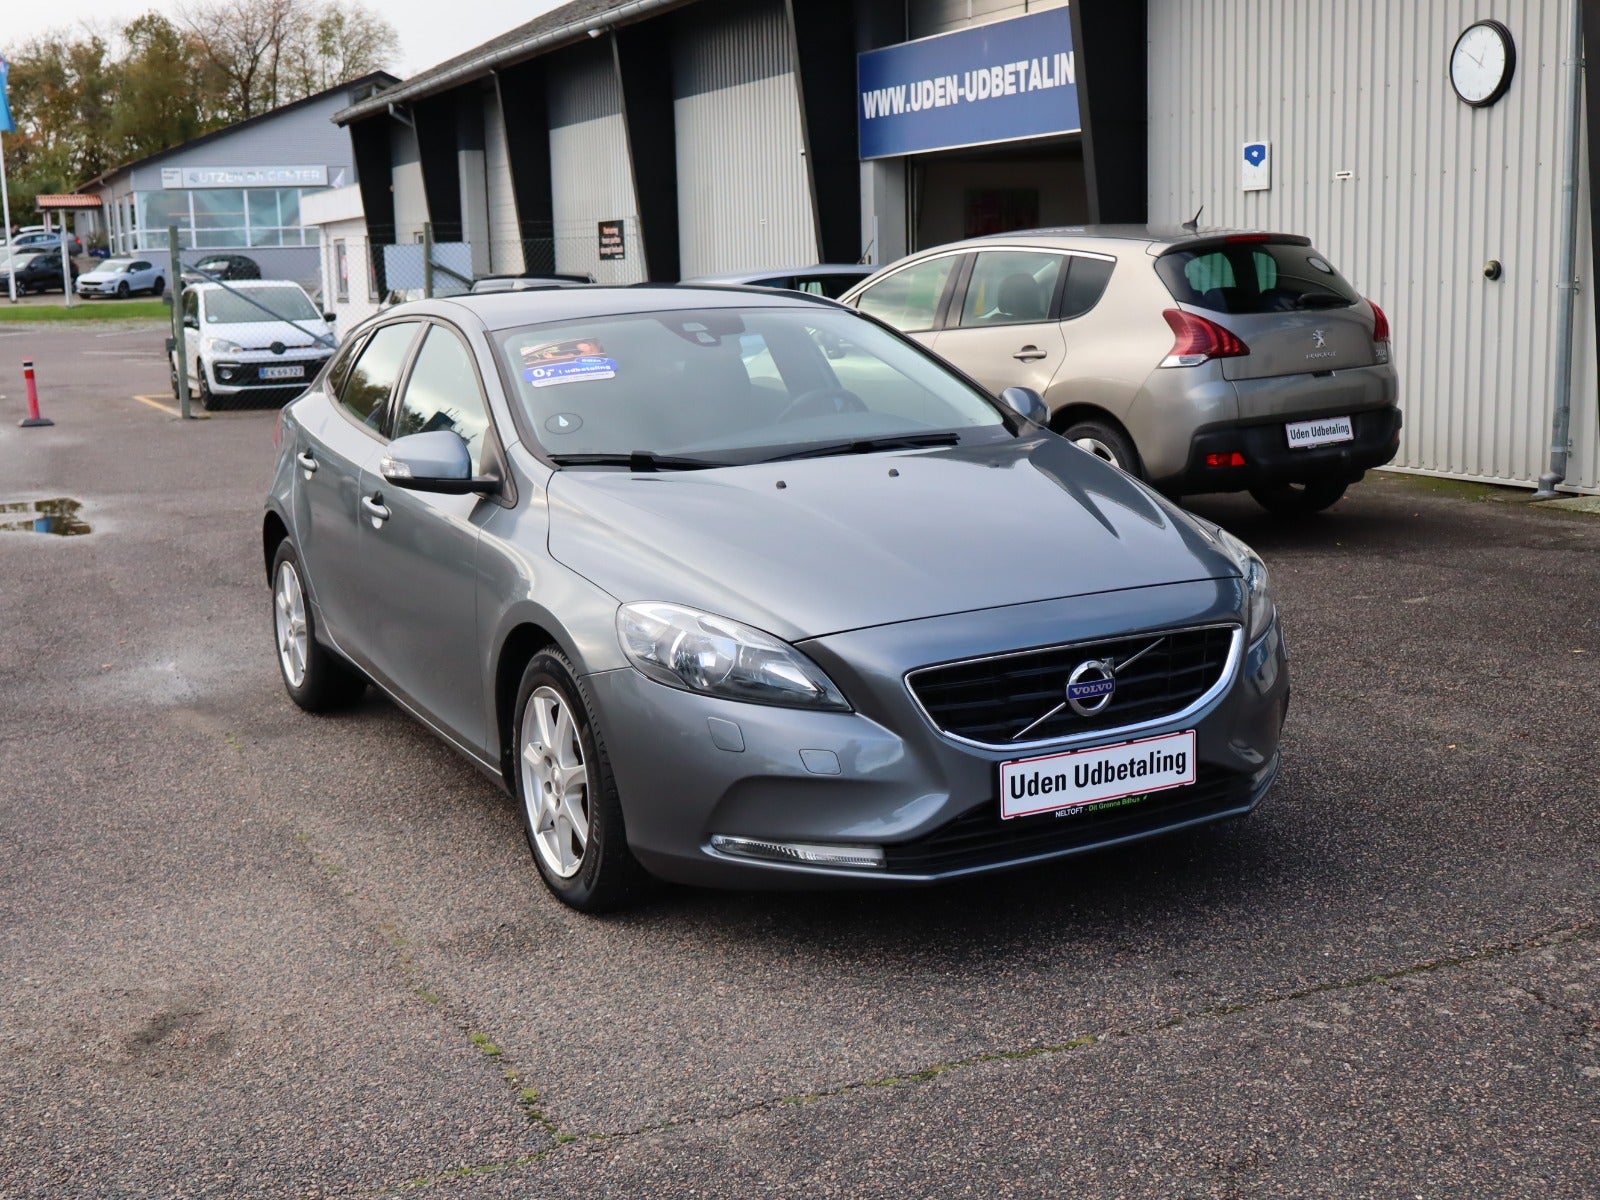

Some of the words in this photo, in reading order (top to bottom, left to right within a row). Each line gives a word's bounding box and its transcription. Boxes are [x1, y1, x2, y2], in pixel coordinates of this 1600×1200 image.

[1290, 428, 1310, 440] Uden
[1311, 423, 1350, 437] Udbetaling
[1072, 682, 1113, 695] VOLVO
[1010, 771, 1067, 799] Uden
[1074, 750, 1187, 788] Udbetaling
[1055, 806, 1083, 818] NELTOFT
